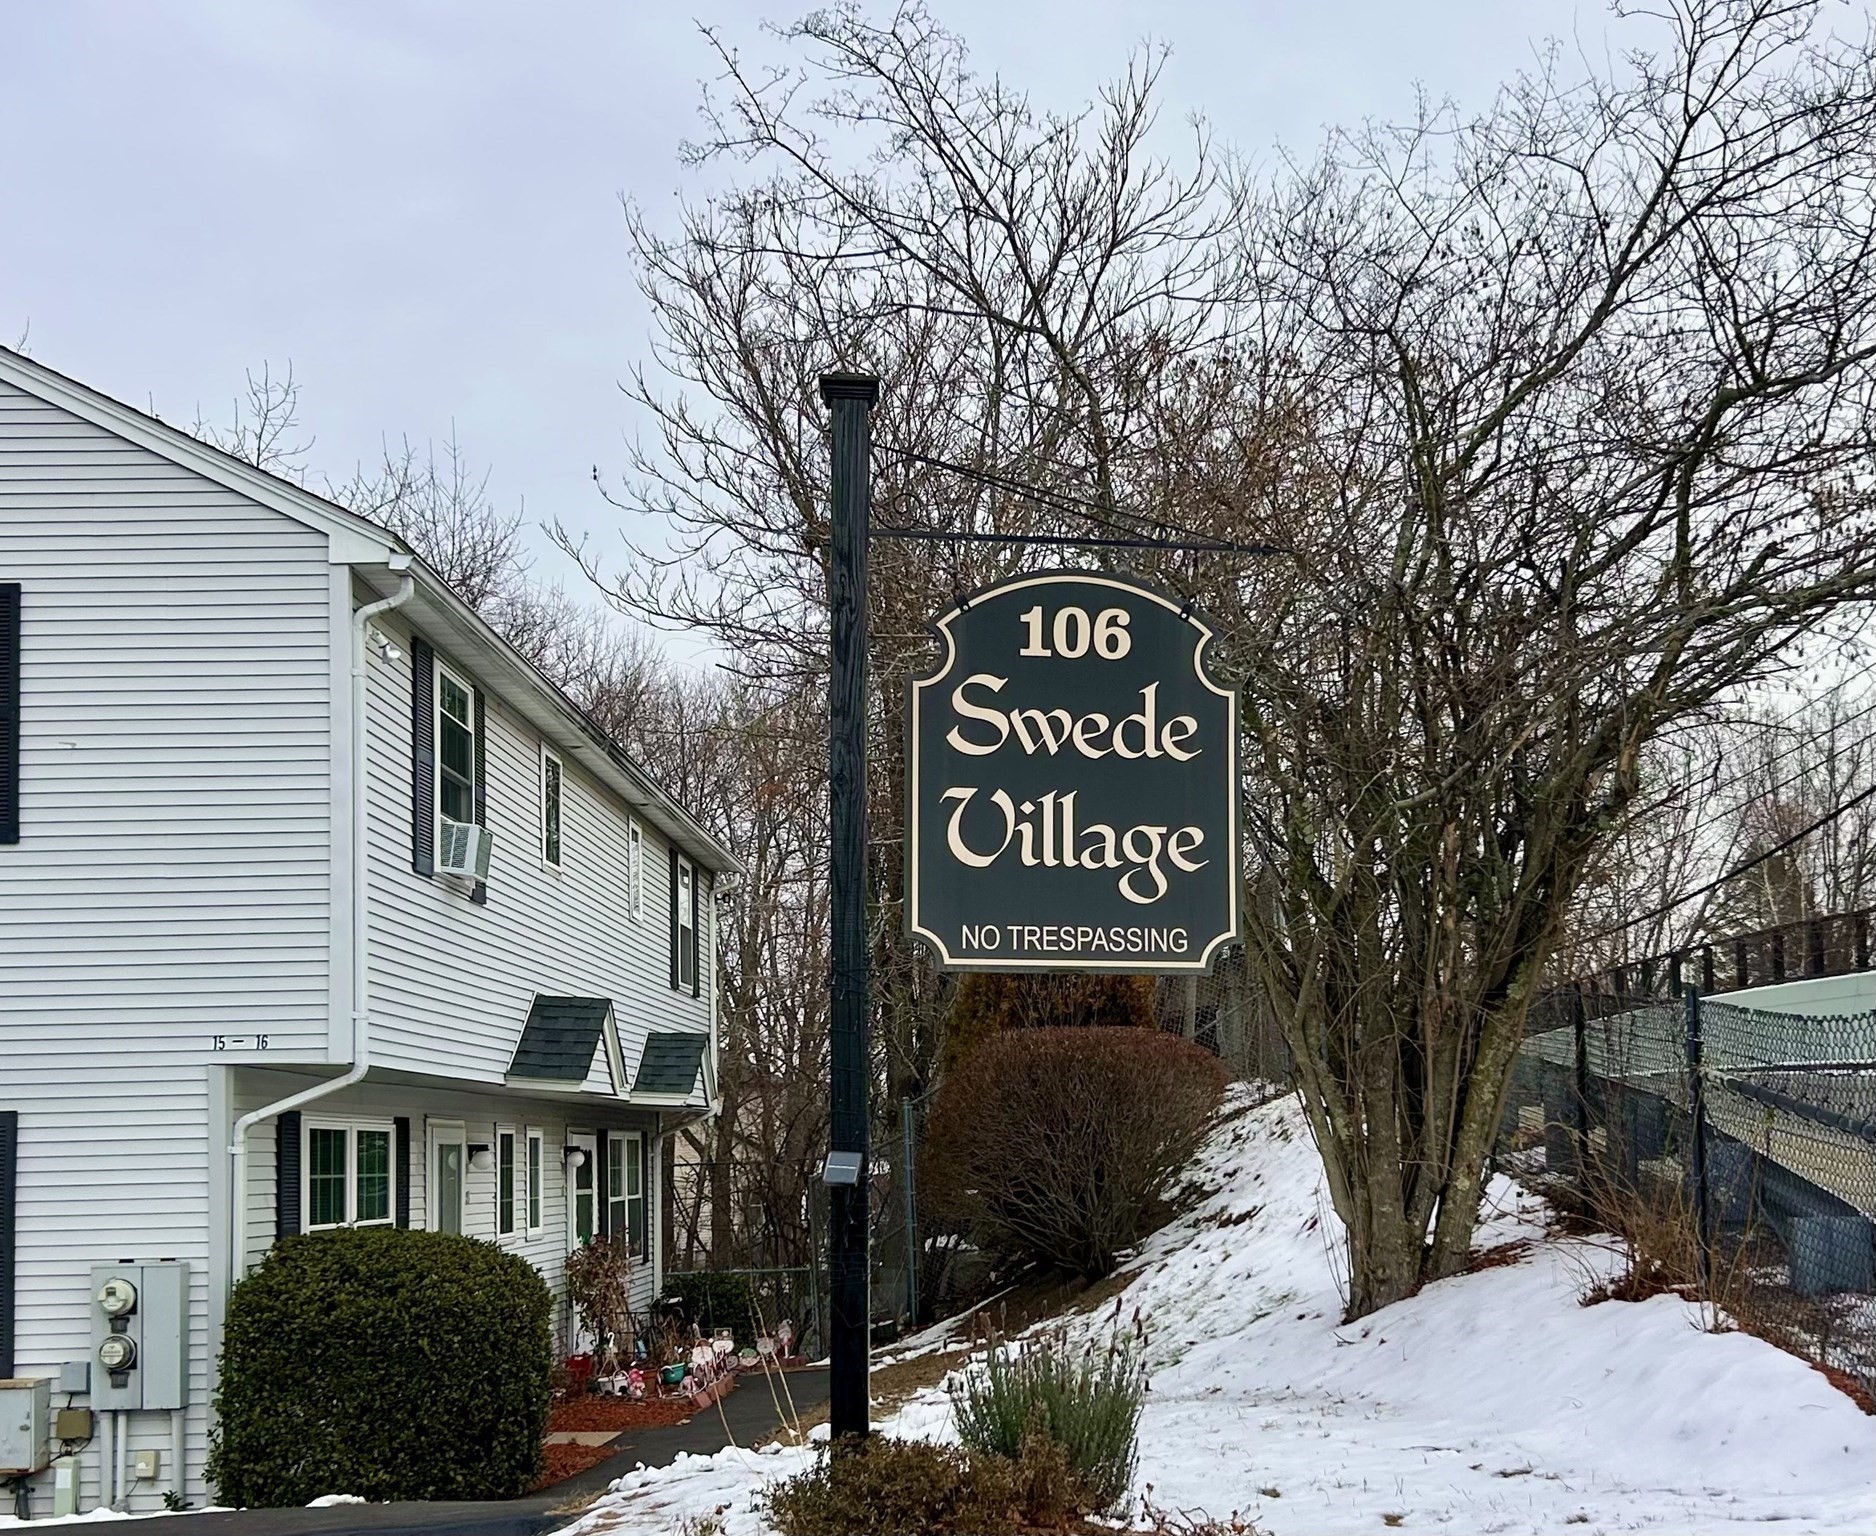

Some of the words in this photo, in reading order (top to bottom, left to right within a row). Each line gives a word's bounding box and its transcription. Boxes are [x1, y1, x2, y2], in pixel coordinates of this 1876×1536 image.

[1018, 605, 1133, 661] 106
[945, 673, 1203, 762] Swede
[938, 786, 1210, 905] Village
[961, 924, 1001, 950] NO
[1006, 924, 1189, 953] TRESPASSING
[212, 1035, 226, 1051] 15
[256, 1034, 269, 1050] 16
